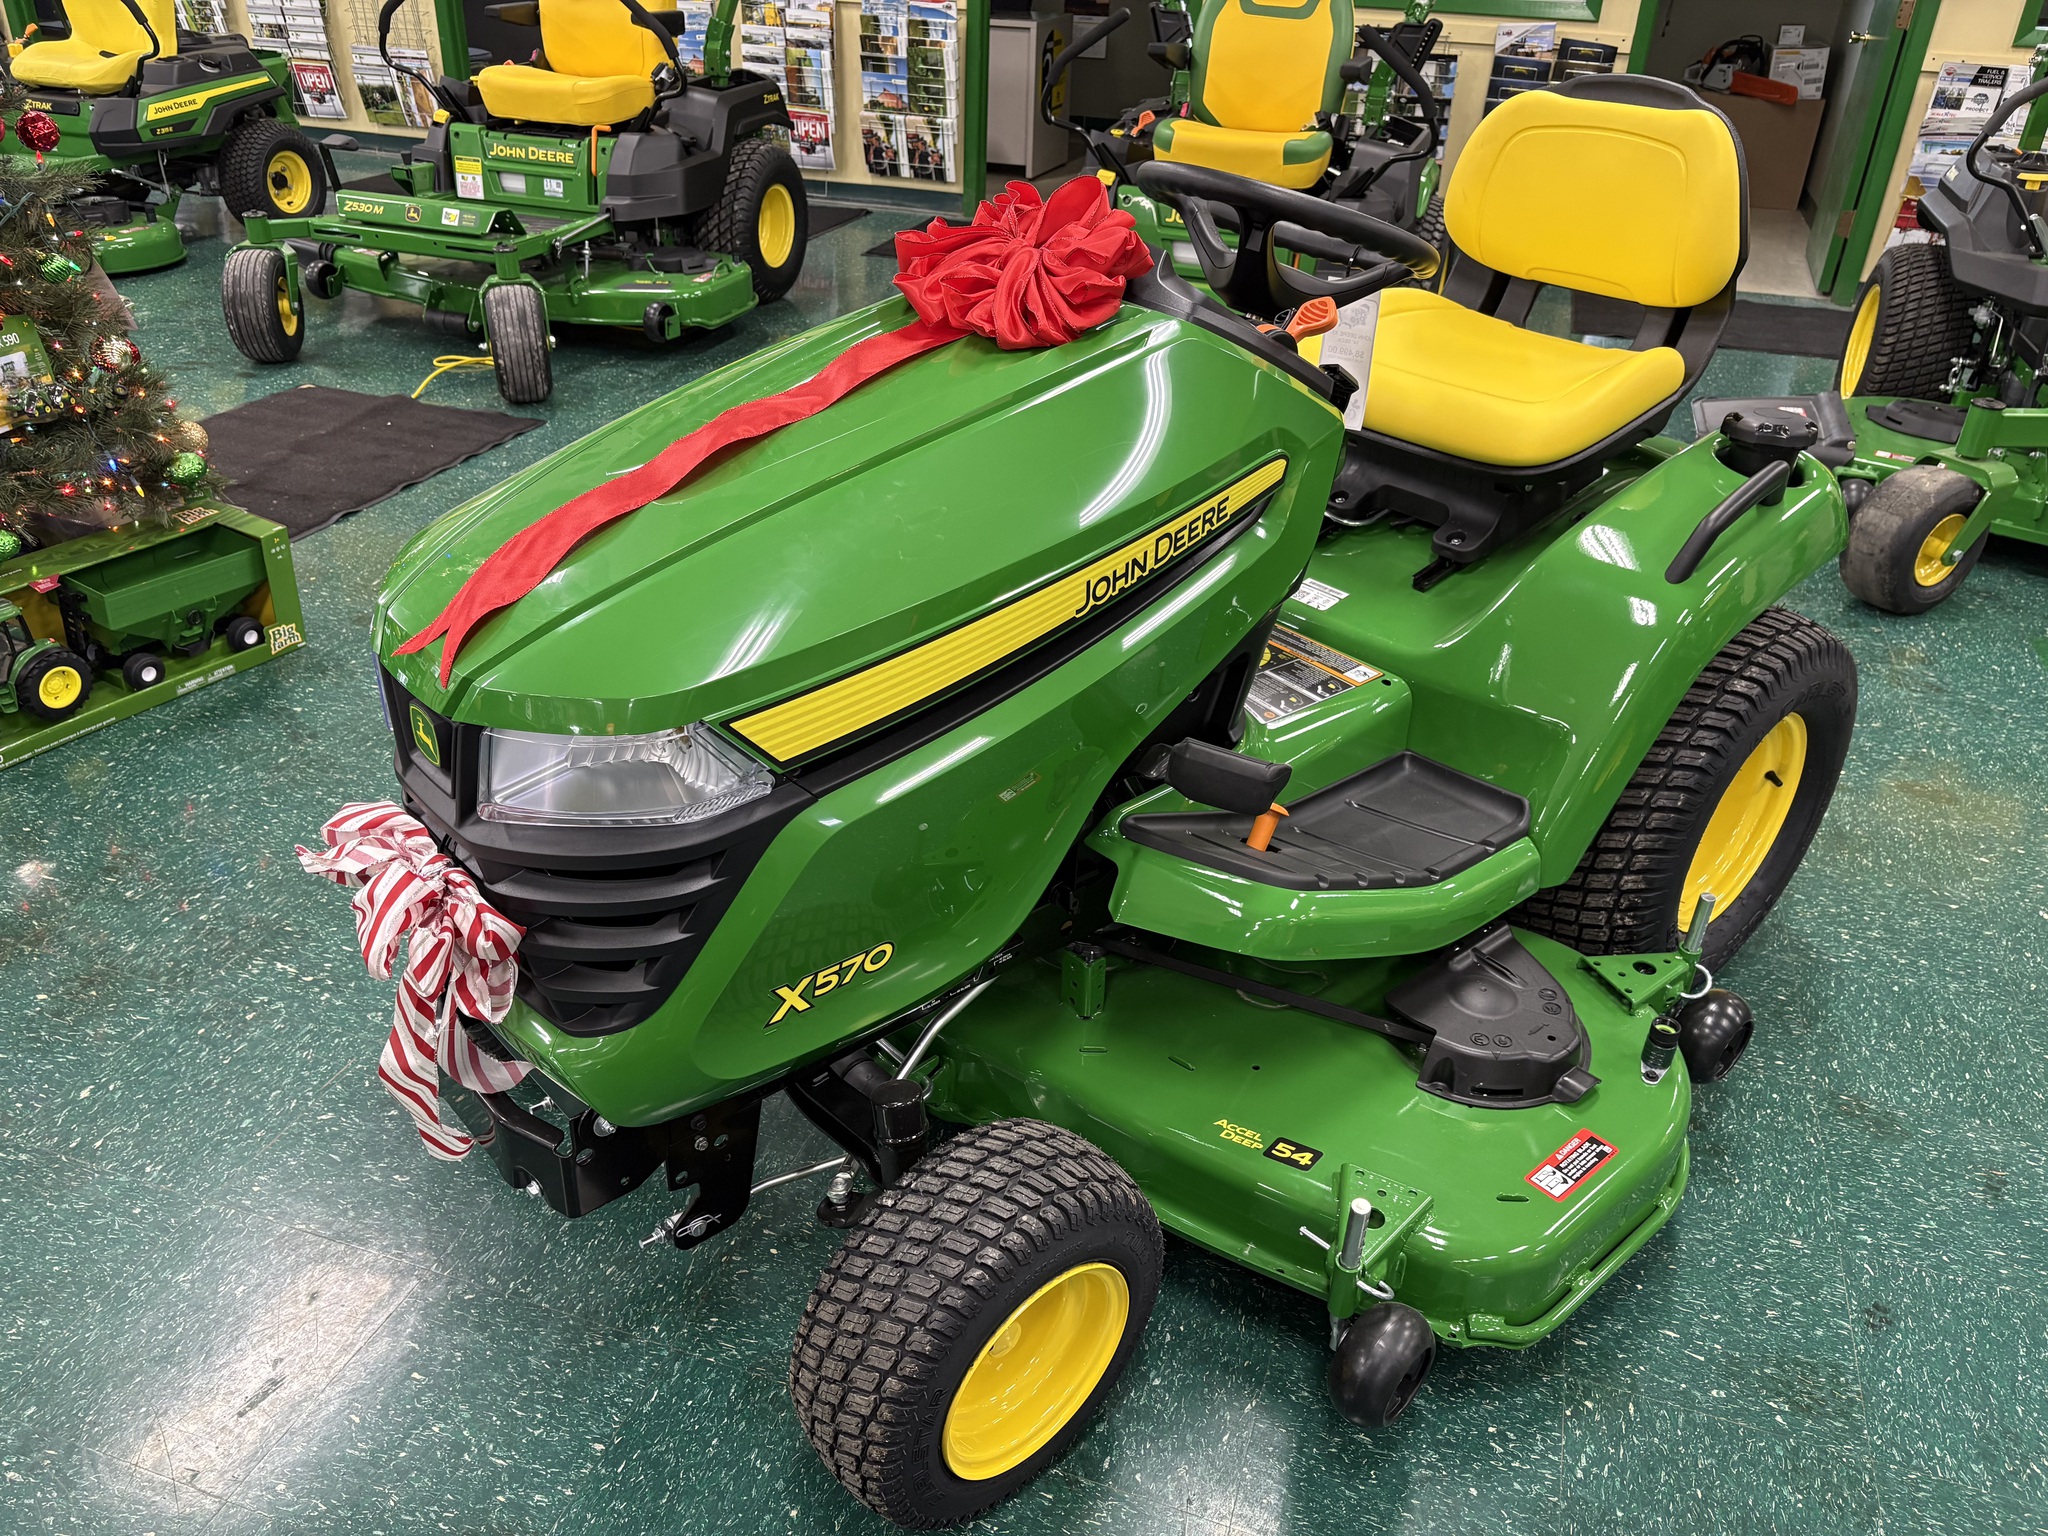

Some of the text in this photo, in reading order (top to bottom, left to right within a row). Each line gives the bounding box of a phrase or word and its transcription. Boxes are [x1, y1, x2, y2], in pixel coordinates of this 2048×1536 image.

[153, 98, 199, 115] JOHN DEERE
[489, 142, 575, 165] JOHN DEERE
[2, 332, 20, 347] 590
[1074, 495, 1231, 618] JOHN DEERE
[270, 625, 296, 641] Big
[271, 633, 301, 653] farm
[764, 942, 896, 1028] X570
[1212, 1118, 1263, 1142] ACCEL
[1219, 1129, 1314, 1166] DEEP 54
[1559, 1137, 1582, 1157] DANGER
